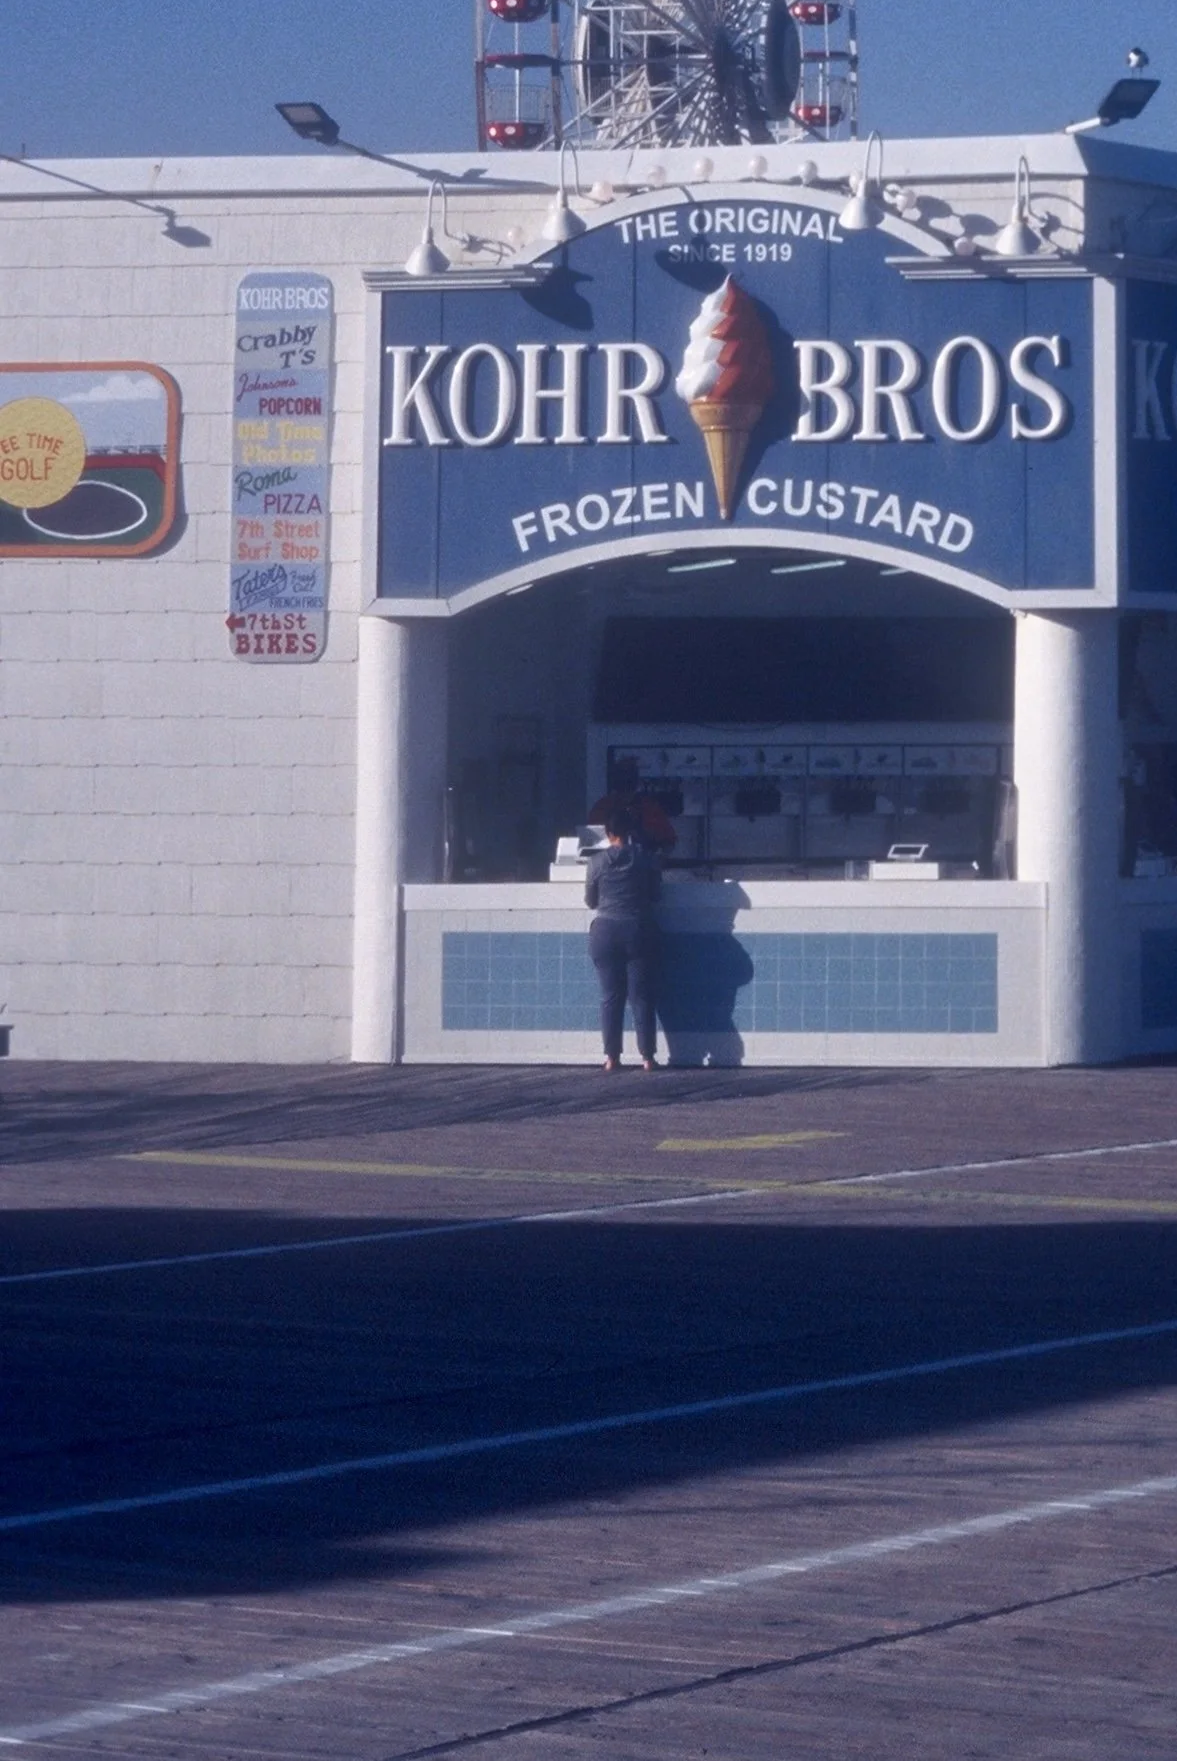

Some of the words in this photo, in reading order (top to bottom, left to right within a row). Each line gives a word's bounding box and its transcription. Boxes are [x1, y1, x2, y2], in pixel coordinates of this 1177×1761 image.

[614, 211, 679, 243] THE
[688, 207, 844, 243] ORIGINAL
[668, 243, 736, 263] SINCE
[743, 243, 793, 262] 1919
[240, 289, 282, 310] KOHR
[285, 288, 329, 309] BROS
[237, 325, 317, 352] Crabby
[383, 343, 670, 446] KOHR
[791, 335, 1068, 441] BROS
[259, 397, 322, 415] POPCORN
[237, 422, 269, 440] Old
[276, 420, 324, 440] Time
[26, 432, 64, 456] TIME
[242, 443, 317, 464] Photos
[1, 457, 56, 481] GOLF
[235, 467, 297, 501] Roma
[264, 493, 322, 514] PIZZA
[512, 482, 704, 553] FROZEN
[748, 478, 974, 553] CUSTARD
[237, 521, 264, 539] 7th
[273, 520, 320, 539] Street
[238, 542, 272, 559] Surf
[281, 542, 319, 560] Shop
[236, 633, 317, 654] BIKES
